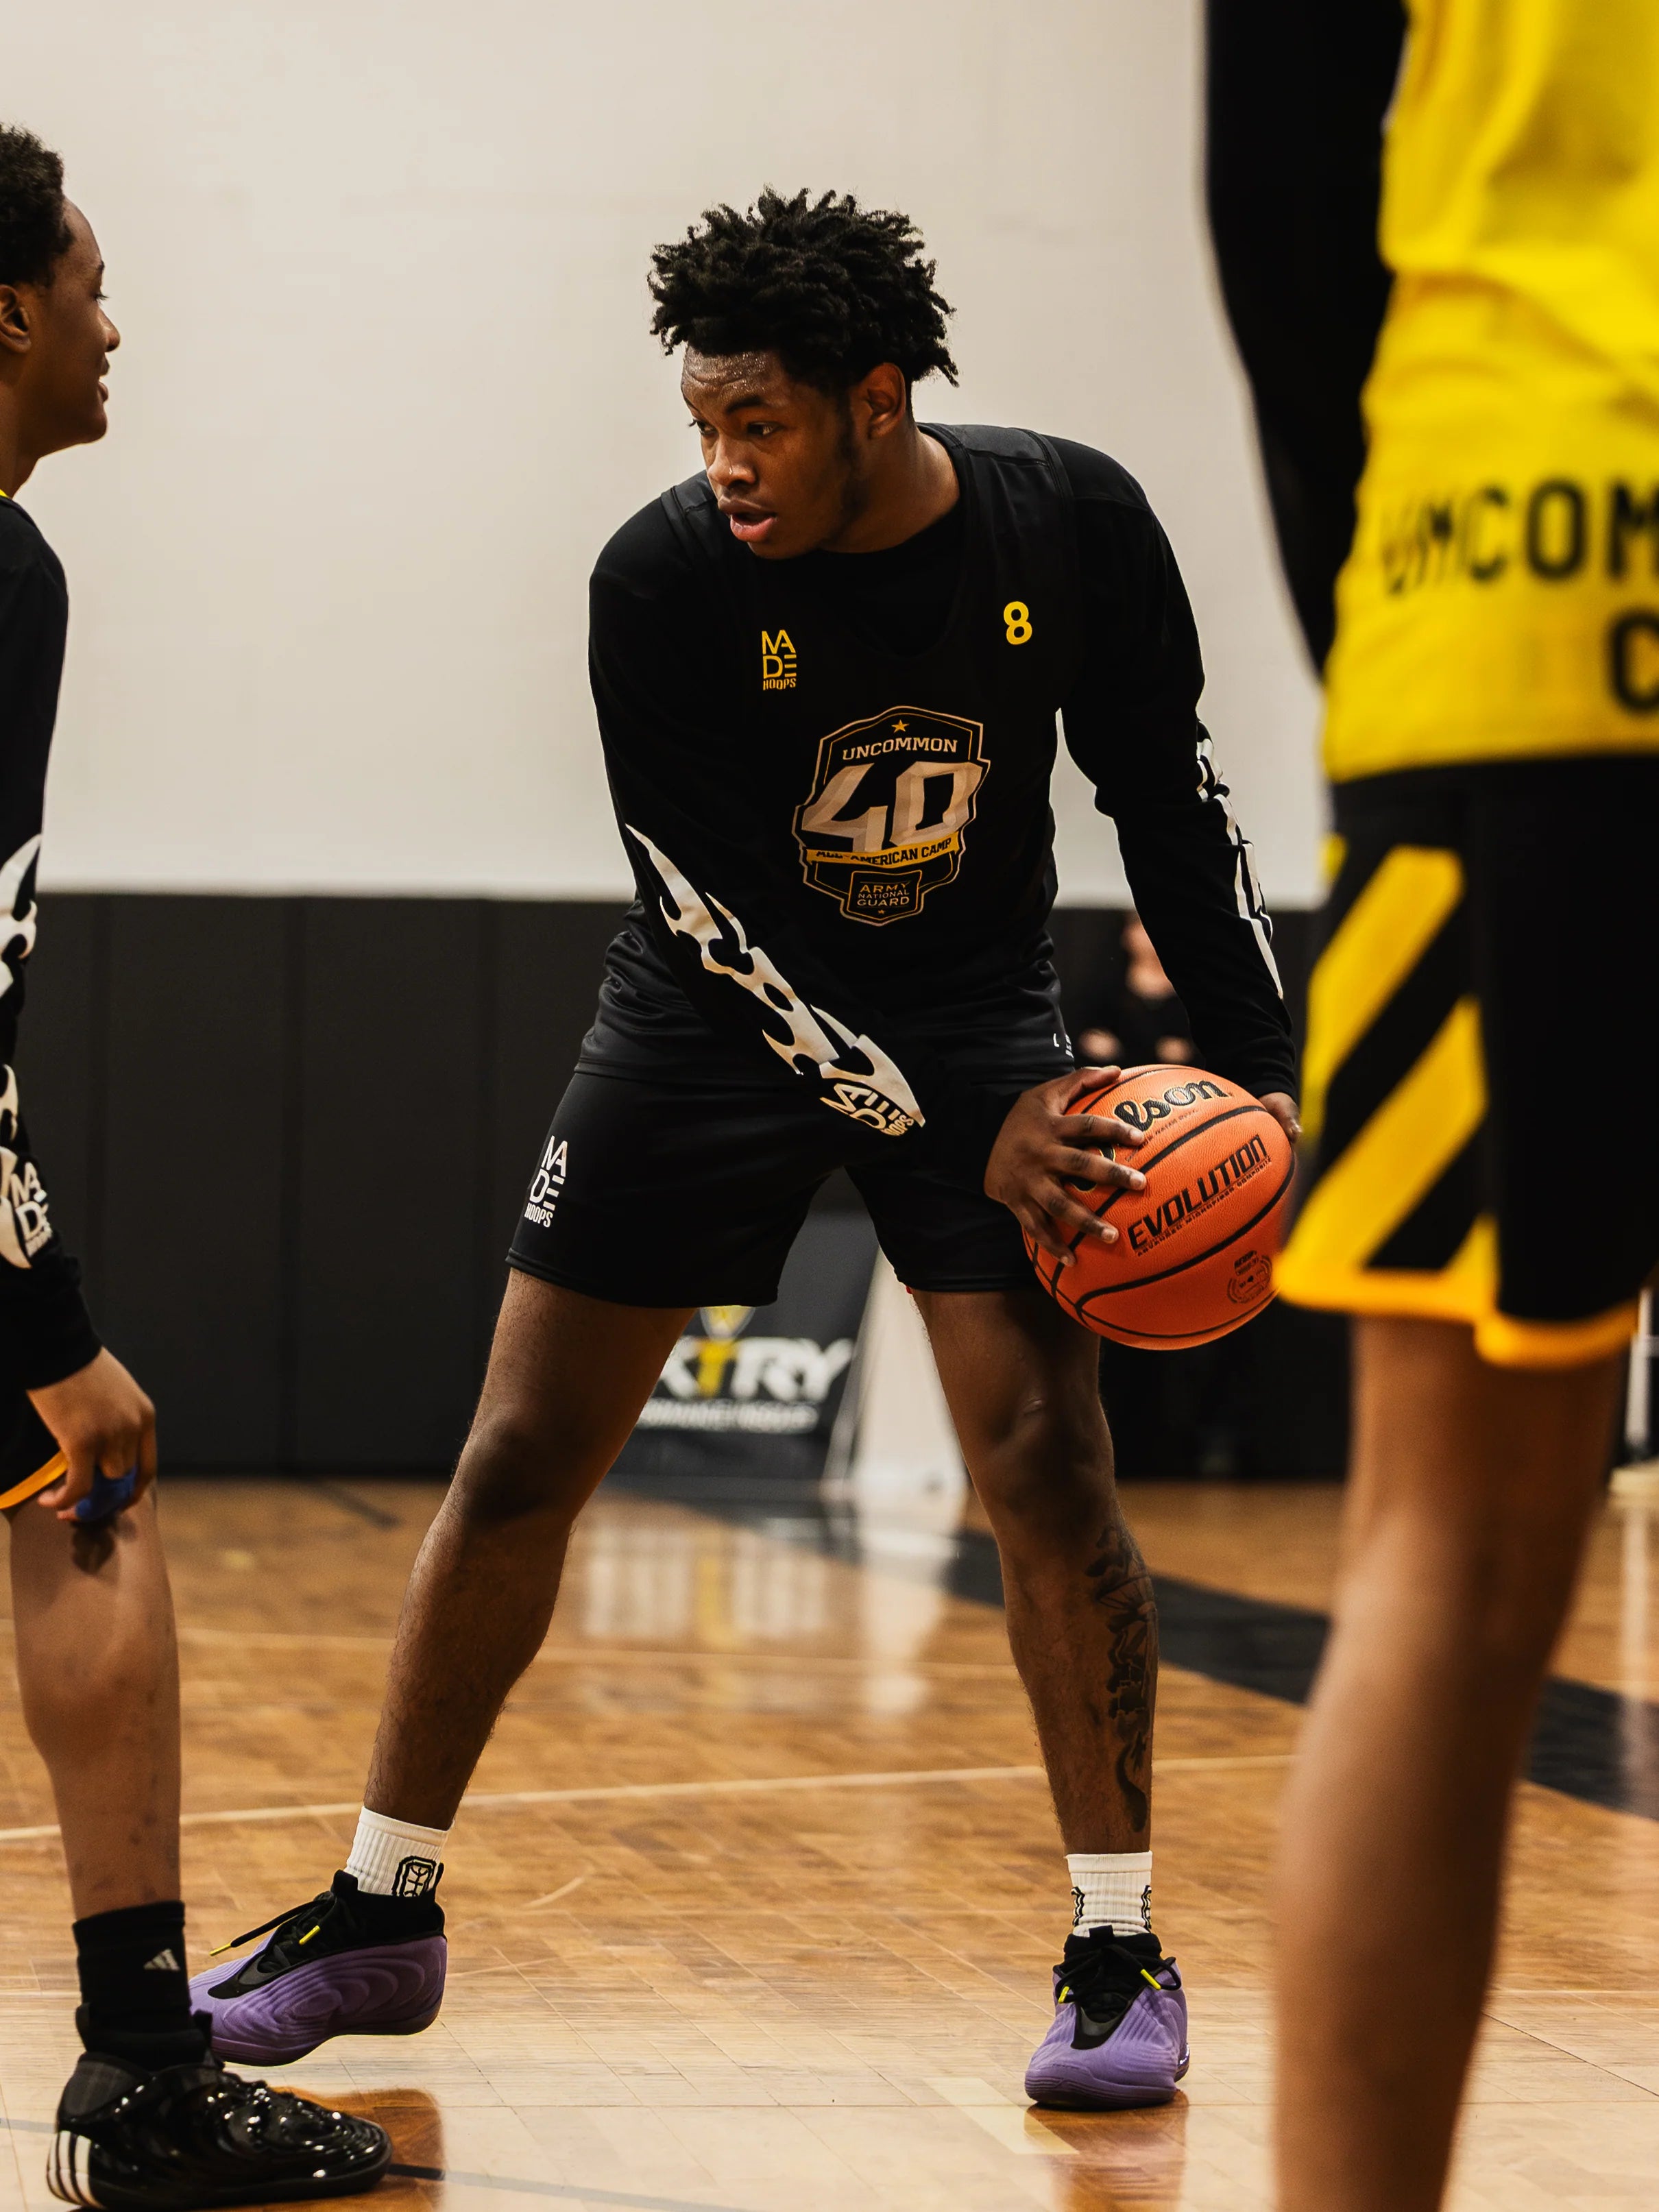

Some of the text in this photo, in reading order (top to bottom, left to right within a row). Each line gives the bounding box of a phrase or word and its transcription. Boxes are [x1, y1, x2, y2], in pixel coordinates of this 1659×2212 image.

[1004, 601, 1032, 645] 8
[763, 678, 797, 691] HOOPS
[843, 738, 958, 761] UNCOMMON
[801, 761, 983, 853] 40
[921, 838, 952, 857] CAMP
[858, 889, 910, 899] NATIONAL
[860, 882, 909, 894] ARMY
[857, 896, 910, 907] GUARD
[1127, 1134, 1268, 1250] EVOLUTION
[524, 1202, 553, 1228] HOOPS
